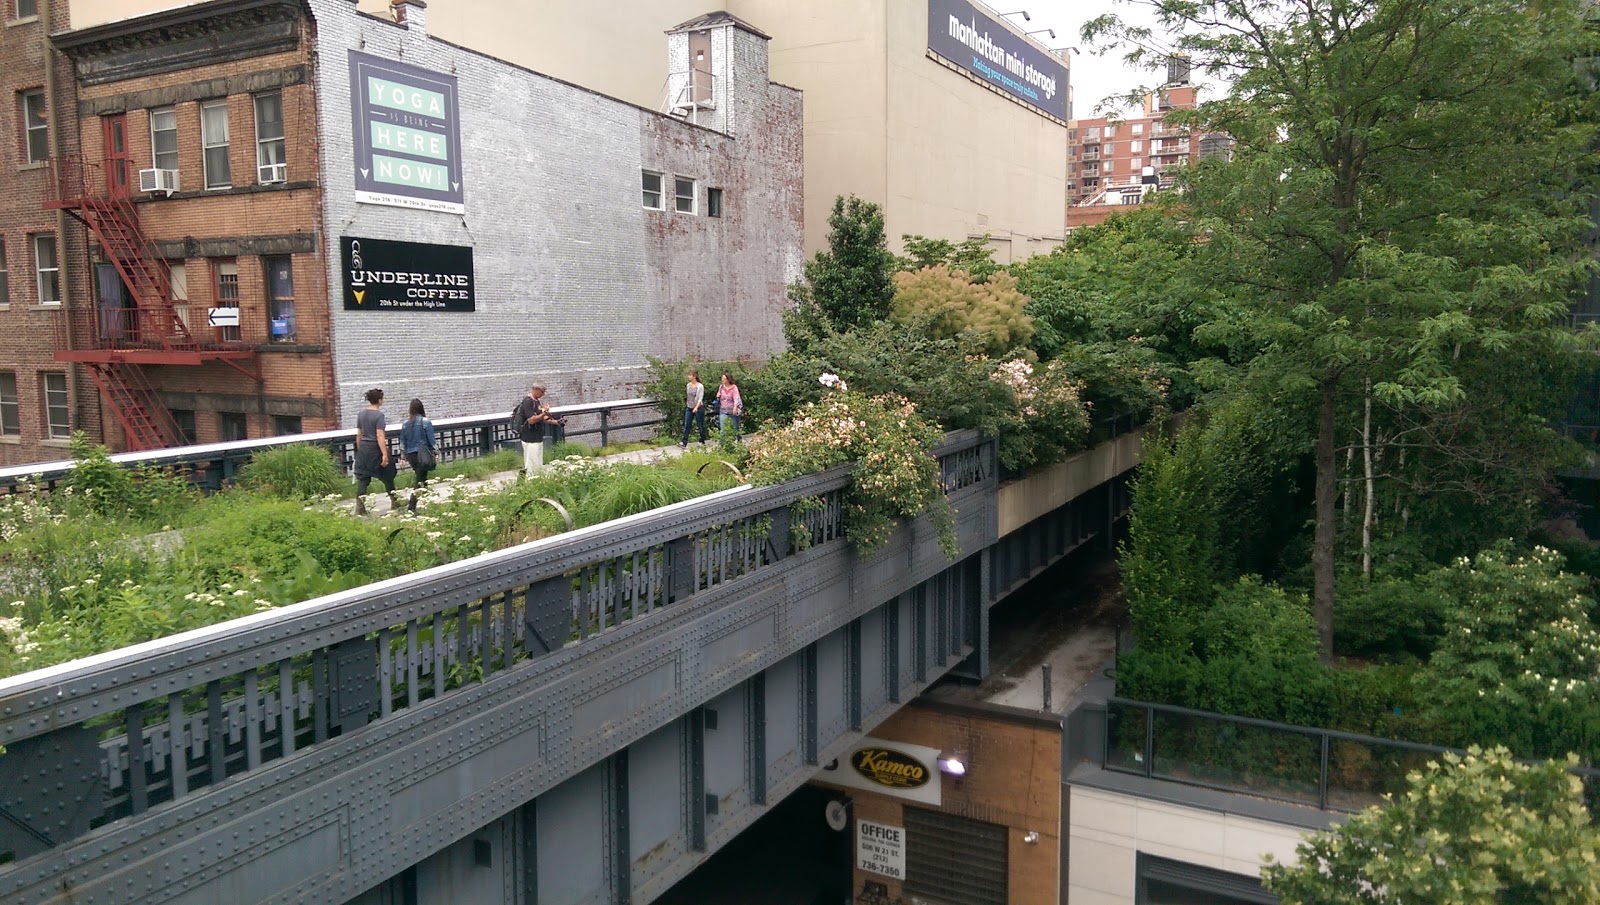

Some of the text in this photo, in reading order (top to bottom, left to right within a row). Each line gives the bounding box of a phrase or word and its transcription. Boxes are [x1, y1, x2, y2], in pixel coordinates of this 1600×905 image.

[948, 14, 1056, 100] manhattan mini storage
[972, 56, 990, 78] Making
[991, 68, 1001, 80] your
[373, 82, 440, 113] YOGA
[390, 112, 429, 128] IS BEING
[377, 127, 440, 154] HERE
[379, 160, 441, 185] NOW!
[351, 271, 468, 286] UNDERLINE
[407, 288, 468, 299] COFFEE
[859, 750, 923, 778] Kamco
[861, 823, 900, 842] OFFICE
[861, 860, 900, 876] 736-7350
[872, 853, 888, 864] (212)
